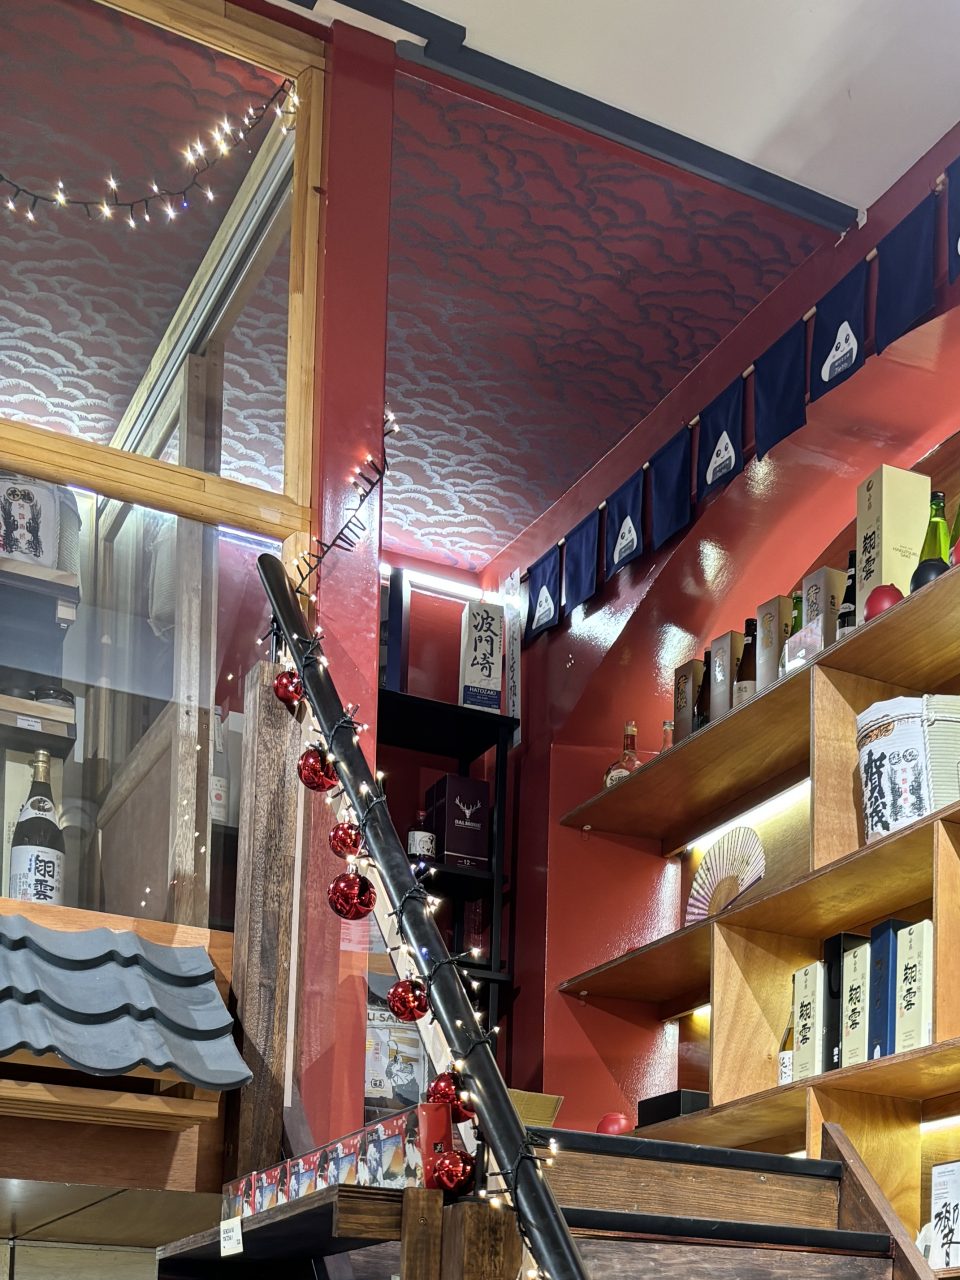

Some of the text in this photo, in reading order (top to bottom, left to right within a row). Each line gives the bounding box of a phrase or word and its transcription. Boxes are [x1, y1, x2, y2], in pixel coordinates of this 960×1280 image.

[471, 609, 499, 679] 波門崎
[469, 686, 496, 696] HATOZAKI
